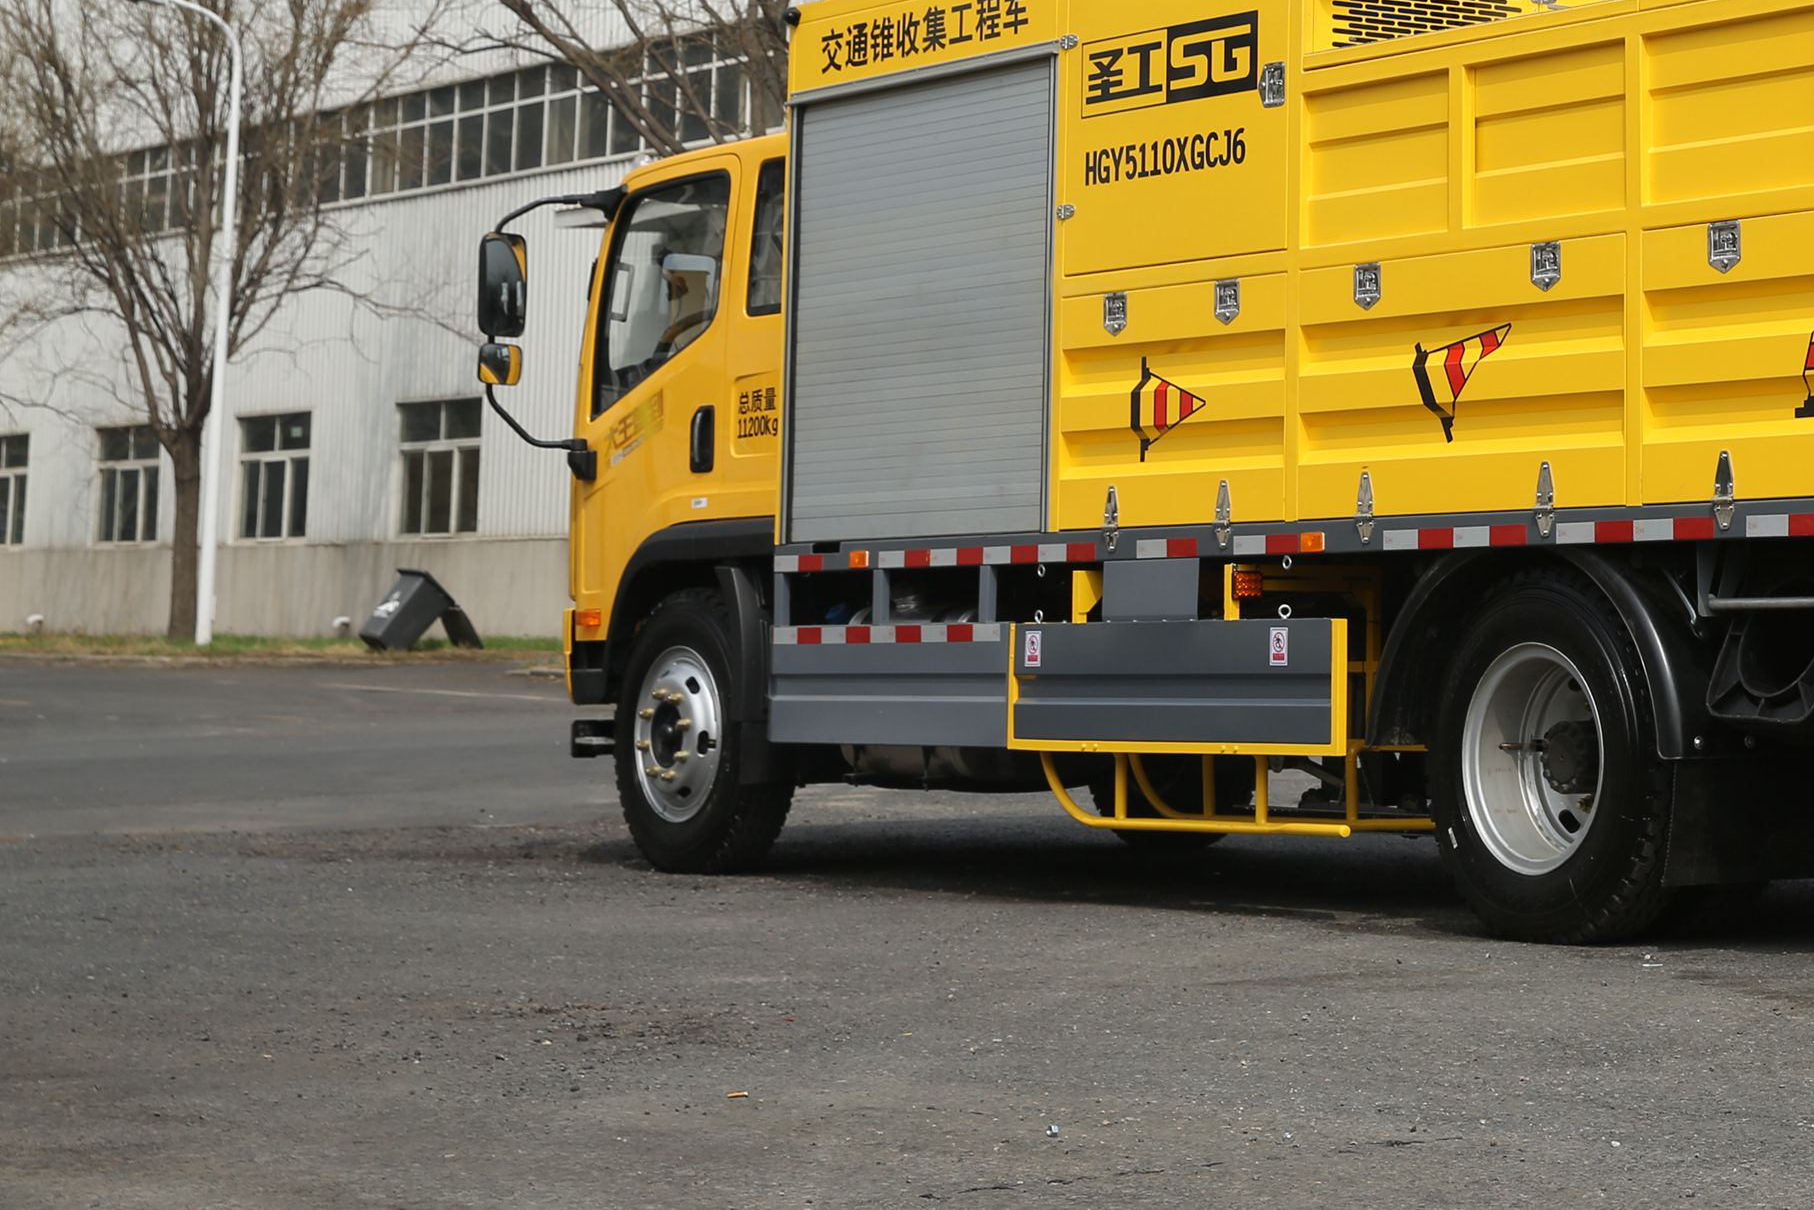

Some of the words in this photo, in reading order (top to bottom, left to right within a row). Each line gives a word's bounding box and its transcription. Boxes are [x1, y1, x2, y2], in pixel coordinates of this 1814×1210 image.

[1085, 127, 1246, 186] HGY5110XGCJ6
[738, 387, 776, 414] 总质量
